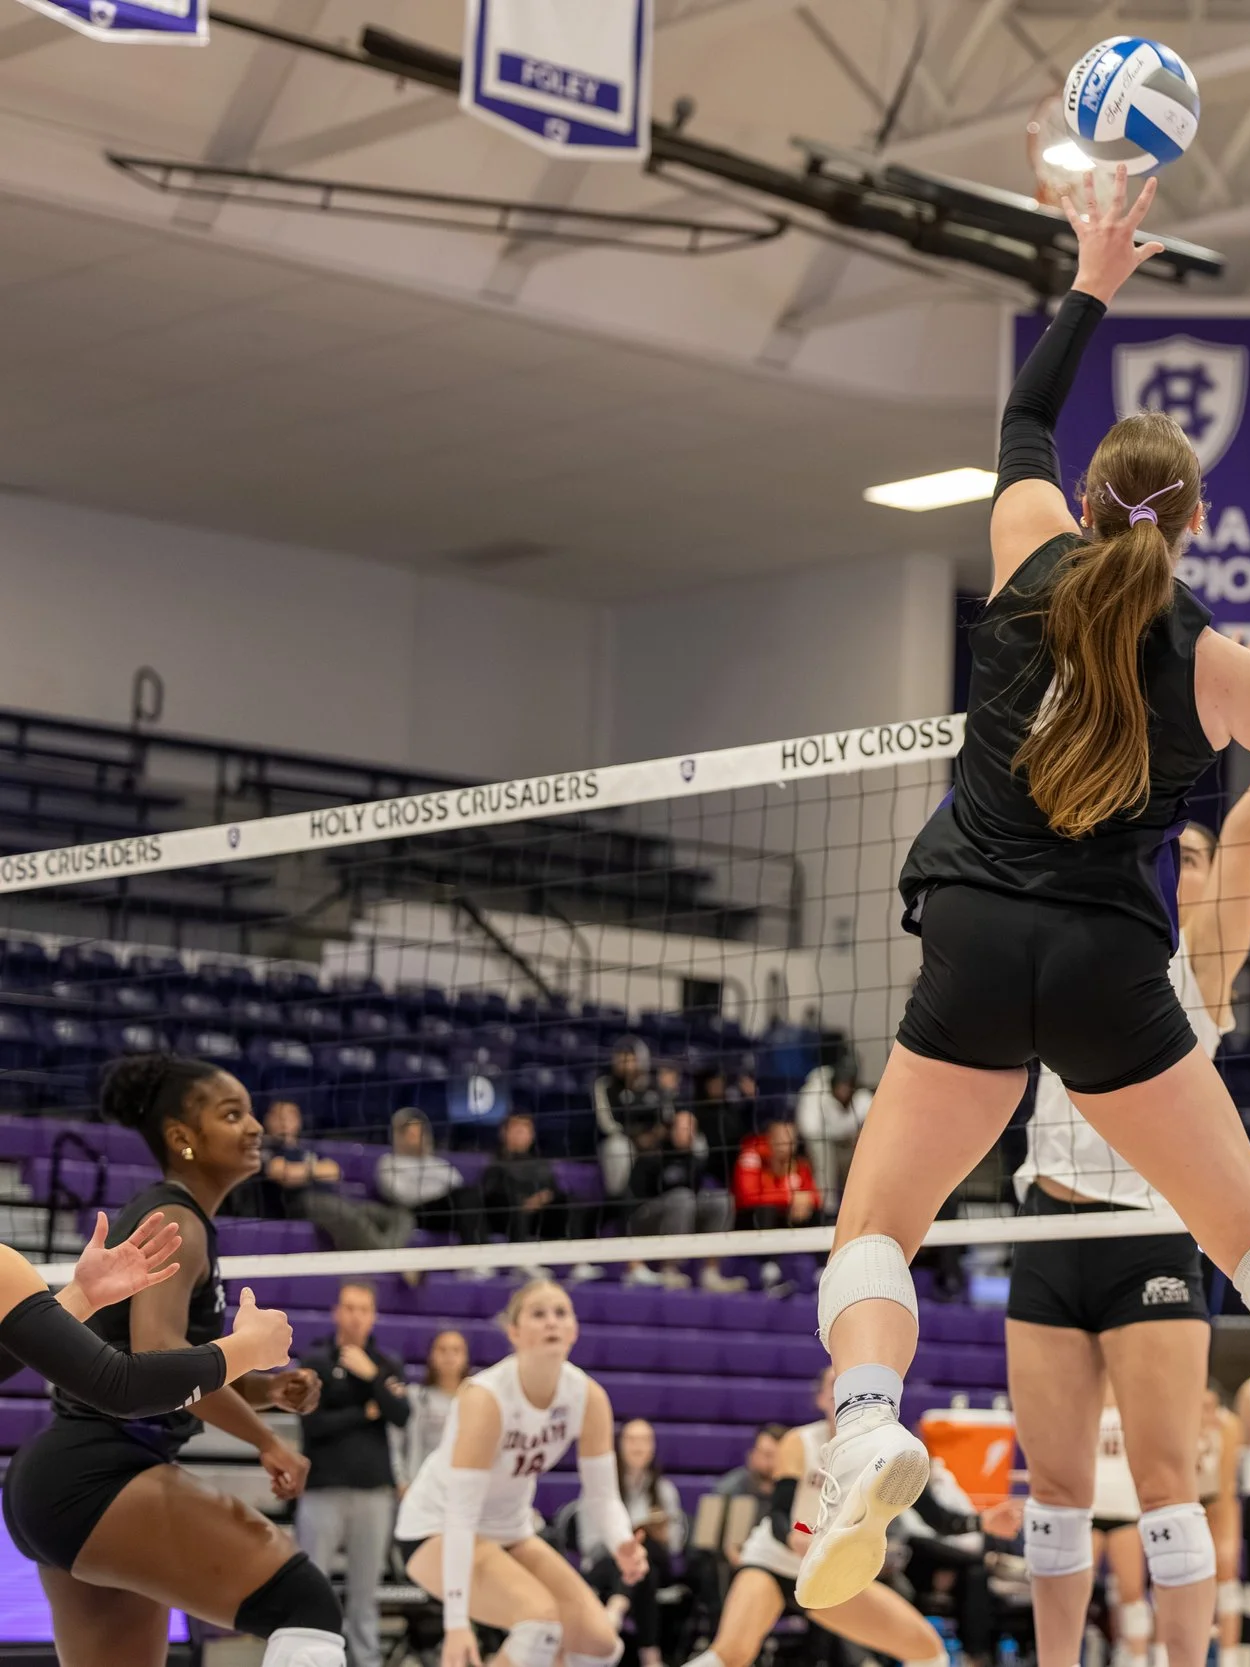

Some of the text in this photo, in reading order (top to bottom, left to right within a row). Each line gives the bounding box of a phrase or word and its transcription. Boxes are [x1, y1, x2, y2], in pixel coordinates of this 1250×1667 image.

[521, 60, 600, 103] FOLEY
[781, 718, 954, 770] HOLY CROSS
[310, 772, 600, 840] HOLY CROSS CRUSADERS
[1, 835, 163, 884] OSS CRUSADERS
[874, 1457, 886, 1471] AM
